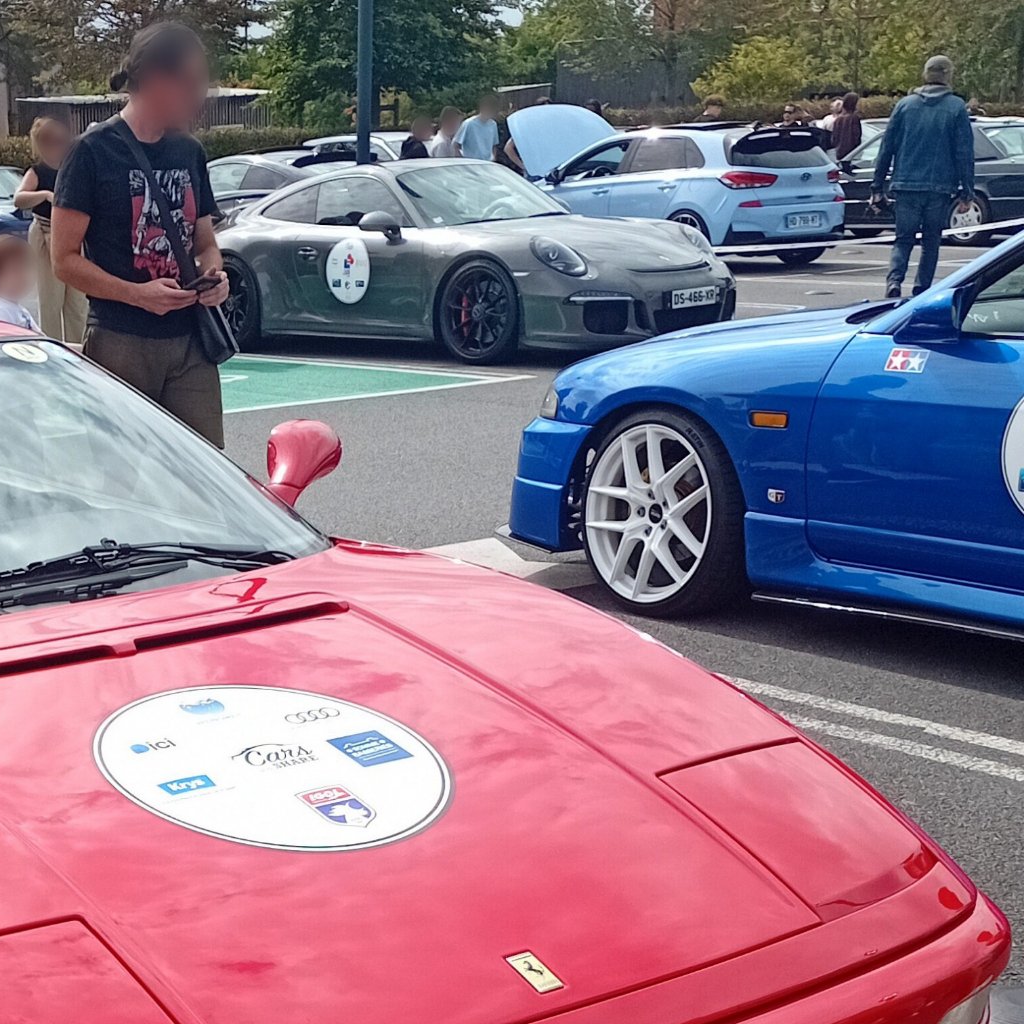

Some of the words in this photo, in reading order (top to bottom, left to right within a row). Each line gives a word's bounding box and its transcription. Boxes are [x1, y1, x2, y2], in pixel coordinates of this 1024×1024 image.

[146, 737, 176, 751] ici
[244, 745, 314, 767] Cars
[167, 778, 206, 792] Krys
